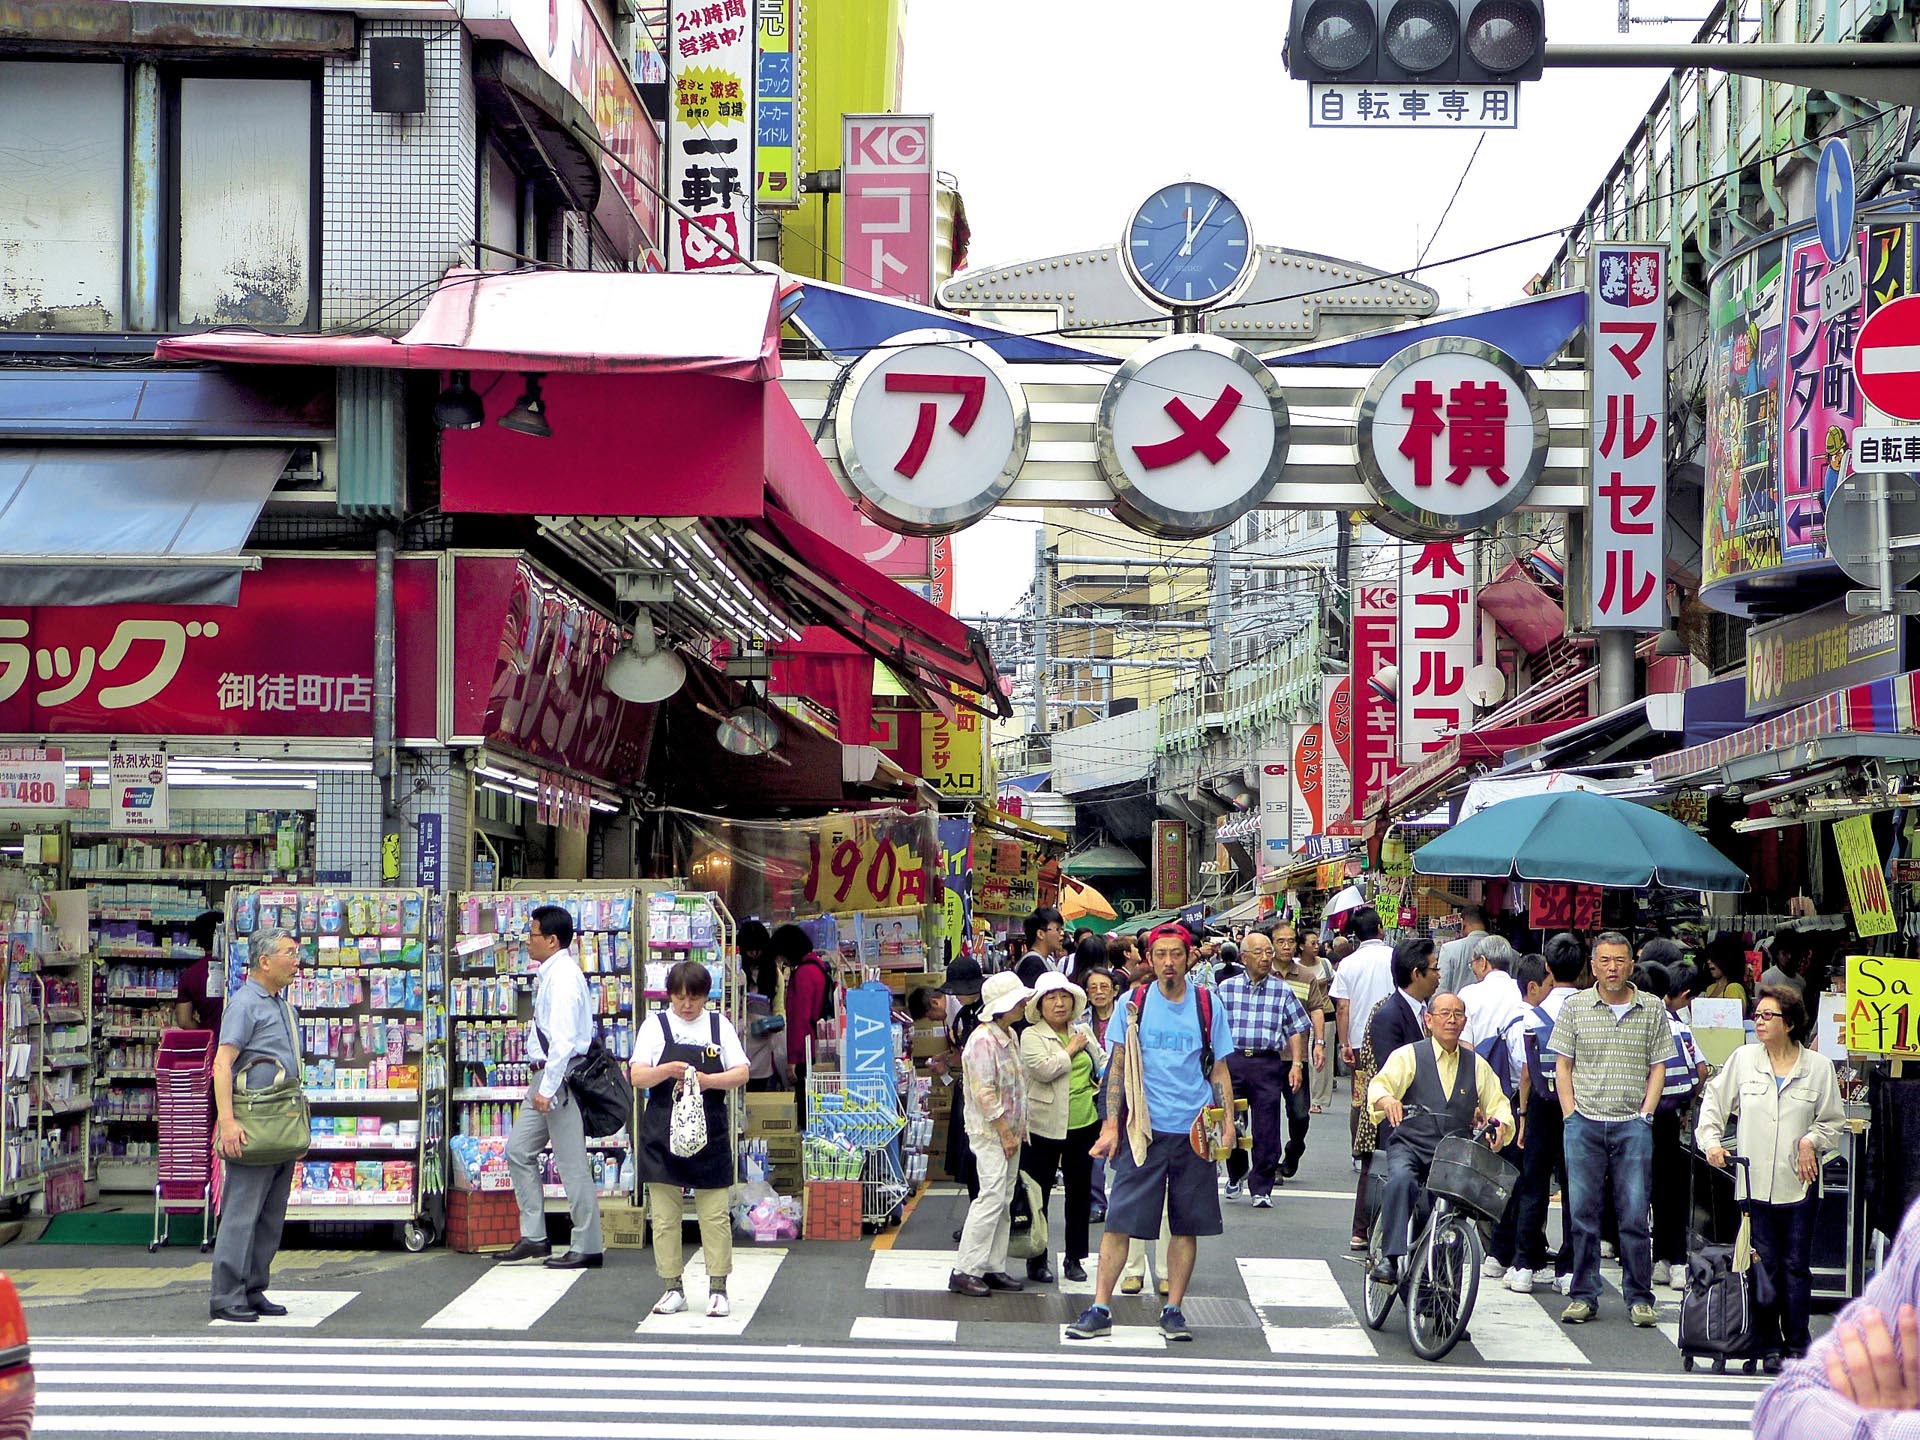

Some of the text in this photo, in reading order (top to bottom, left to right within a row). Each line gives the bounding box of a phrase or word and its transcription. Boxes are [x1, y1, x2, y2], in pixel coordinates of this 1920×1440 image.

[675, 0, 747, 32] 24時間
[678, 25, 745, 58] 営業中!
[709, 80, 739, 98] 激安
[1321, 88, 1509, 122] 自転車専用
[718, 101, 743, 117] 酒場
[850, 126, 926, 166] KG
[1824, 270, 1855, 311] 8-20
[884, 372, 1510, 487] アメ横
[1860, 435, 1920, 464] 自転車
[1597, 322, 1658, 616] マルセル
[216, 672, 373, 713] 御徒町店
[1333, 691, 1351, 745] ロンドン
[112, 753, 164, 769] 热烈欢迎
[1302, 735, 1318, 794] ロンドン
[16, 781, 56, 804] 480
[942, 772, 975, 789] 入口
[985, 875, 1034, 888] Sale Sale
[1009, 889, 1033, 900] Sale
[1008, 901, 1032, 912] Sale
[1870, 1002, 1920, 1053] ¥1,
[495, 1178, 512, 1188] 298
